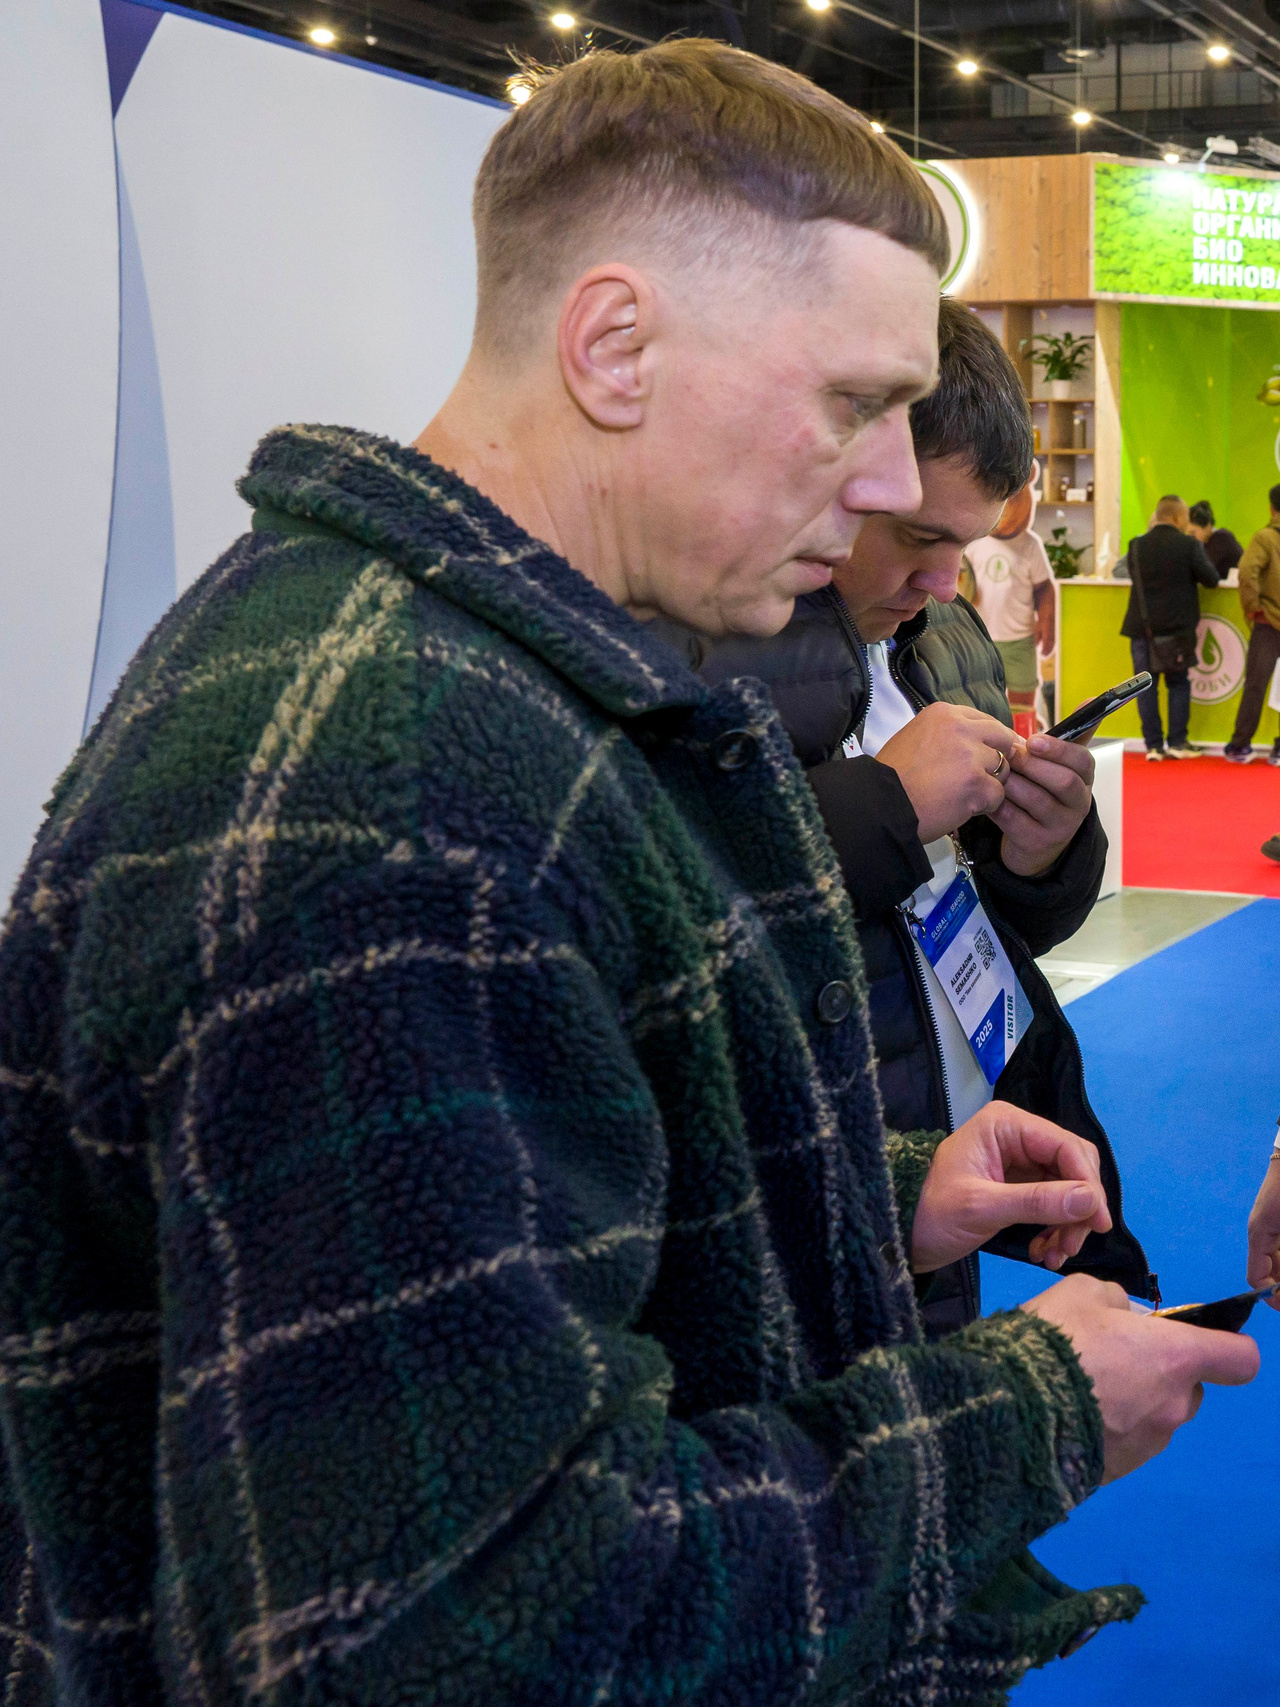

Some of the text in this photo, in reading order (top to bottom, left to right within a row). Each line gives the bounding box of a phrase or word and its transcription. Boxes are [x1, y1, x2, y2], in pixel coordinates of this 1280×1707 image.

[1193, 237, 1243, 263] БИО
[931, 917, 947, 938] GLOBAL
[950, 890, 965, 912] SEAFOOD
[950, 953, 974, 987] ALEKSADNR
[955, 962, 977, 995] SEMASHKO
[975, 1019, 993, 1049] 2025
